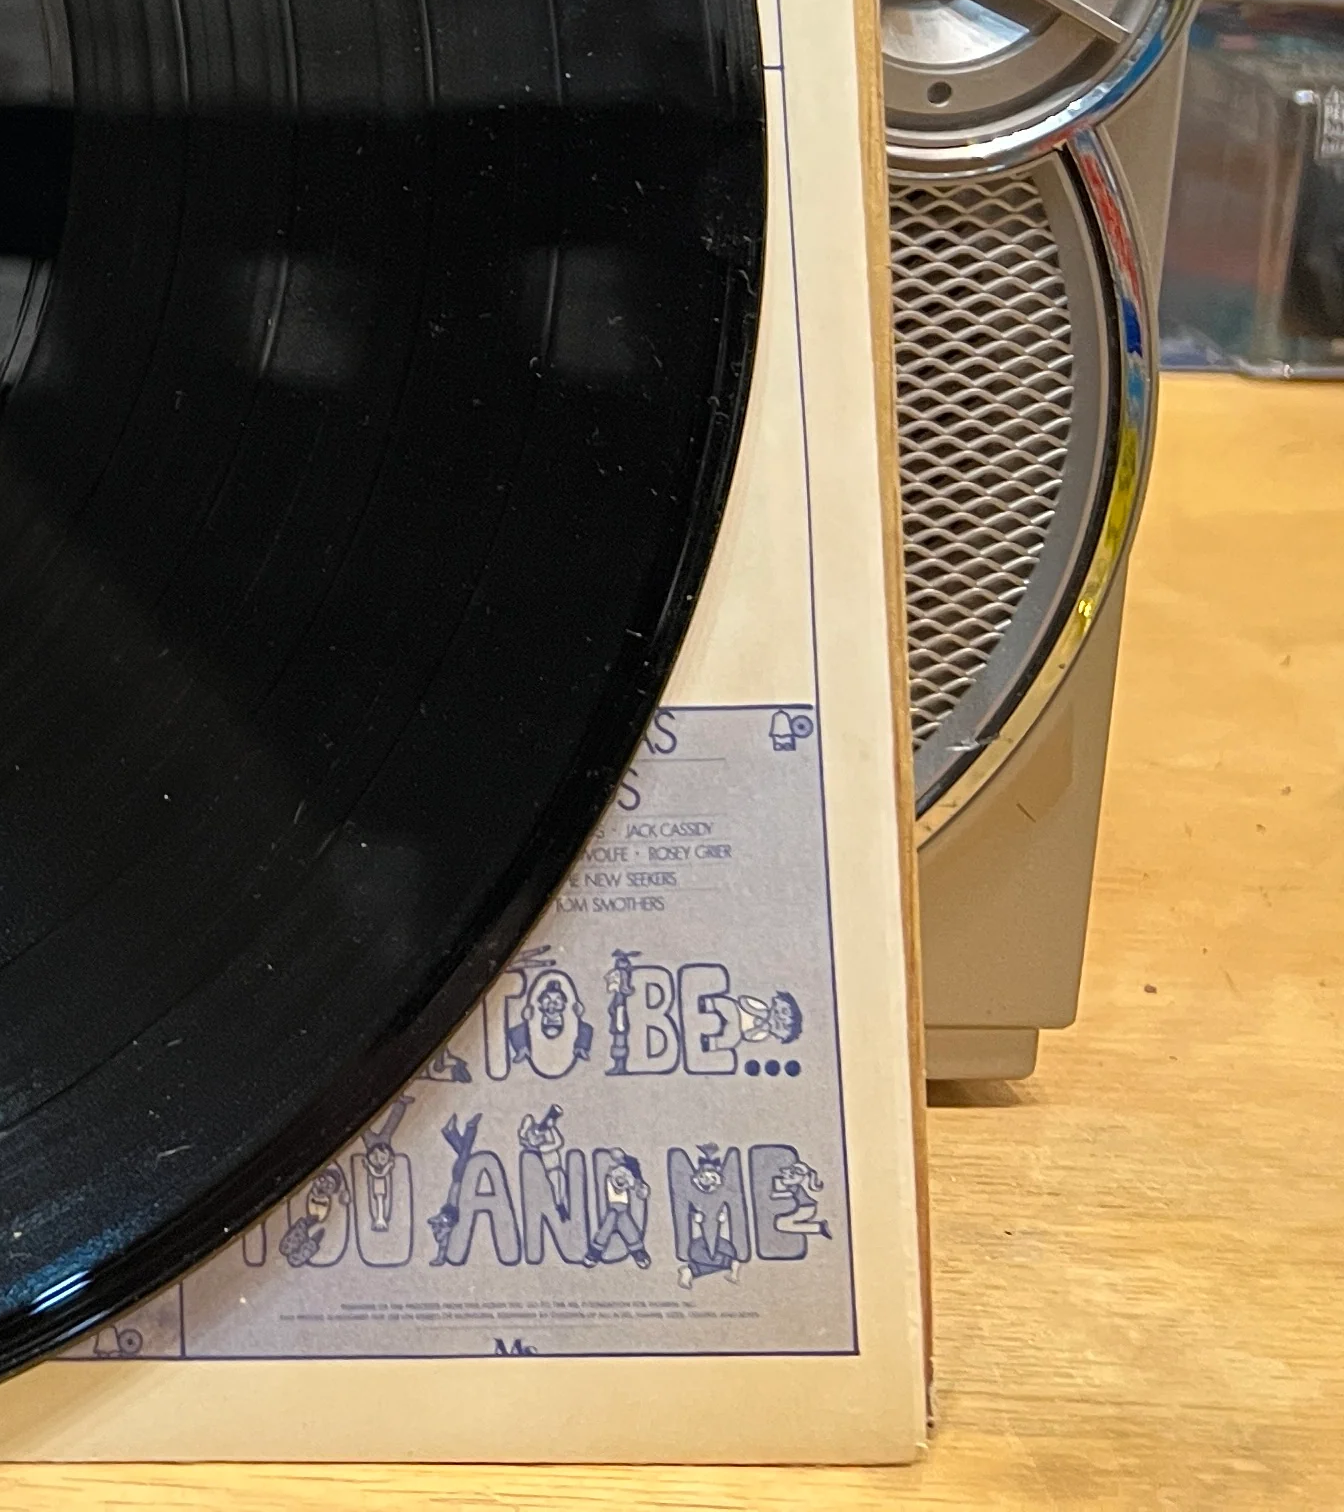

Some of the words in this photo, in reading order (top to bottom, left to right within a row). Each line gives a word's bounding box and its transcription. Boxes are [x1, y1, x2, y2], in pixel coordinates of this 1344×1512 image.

[626, 823, 659, 839] JACK
[585, 872, 622, 888] NEW
[483, 968, 590, 1080] TO
[447, 1147, 652, 1270] AND
[665, 1144, 824, 1268] ME
